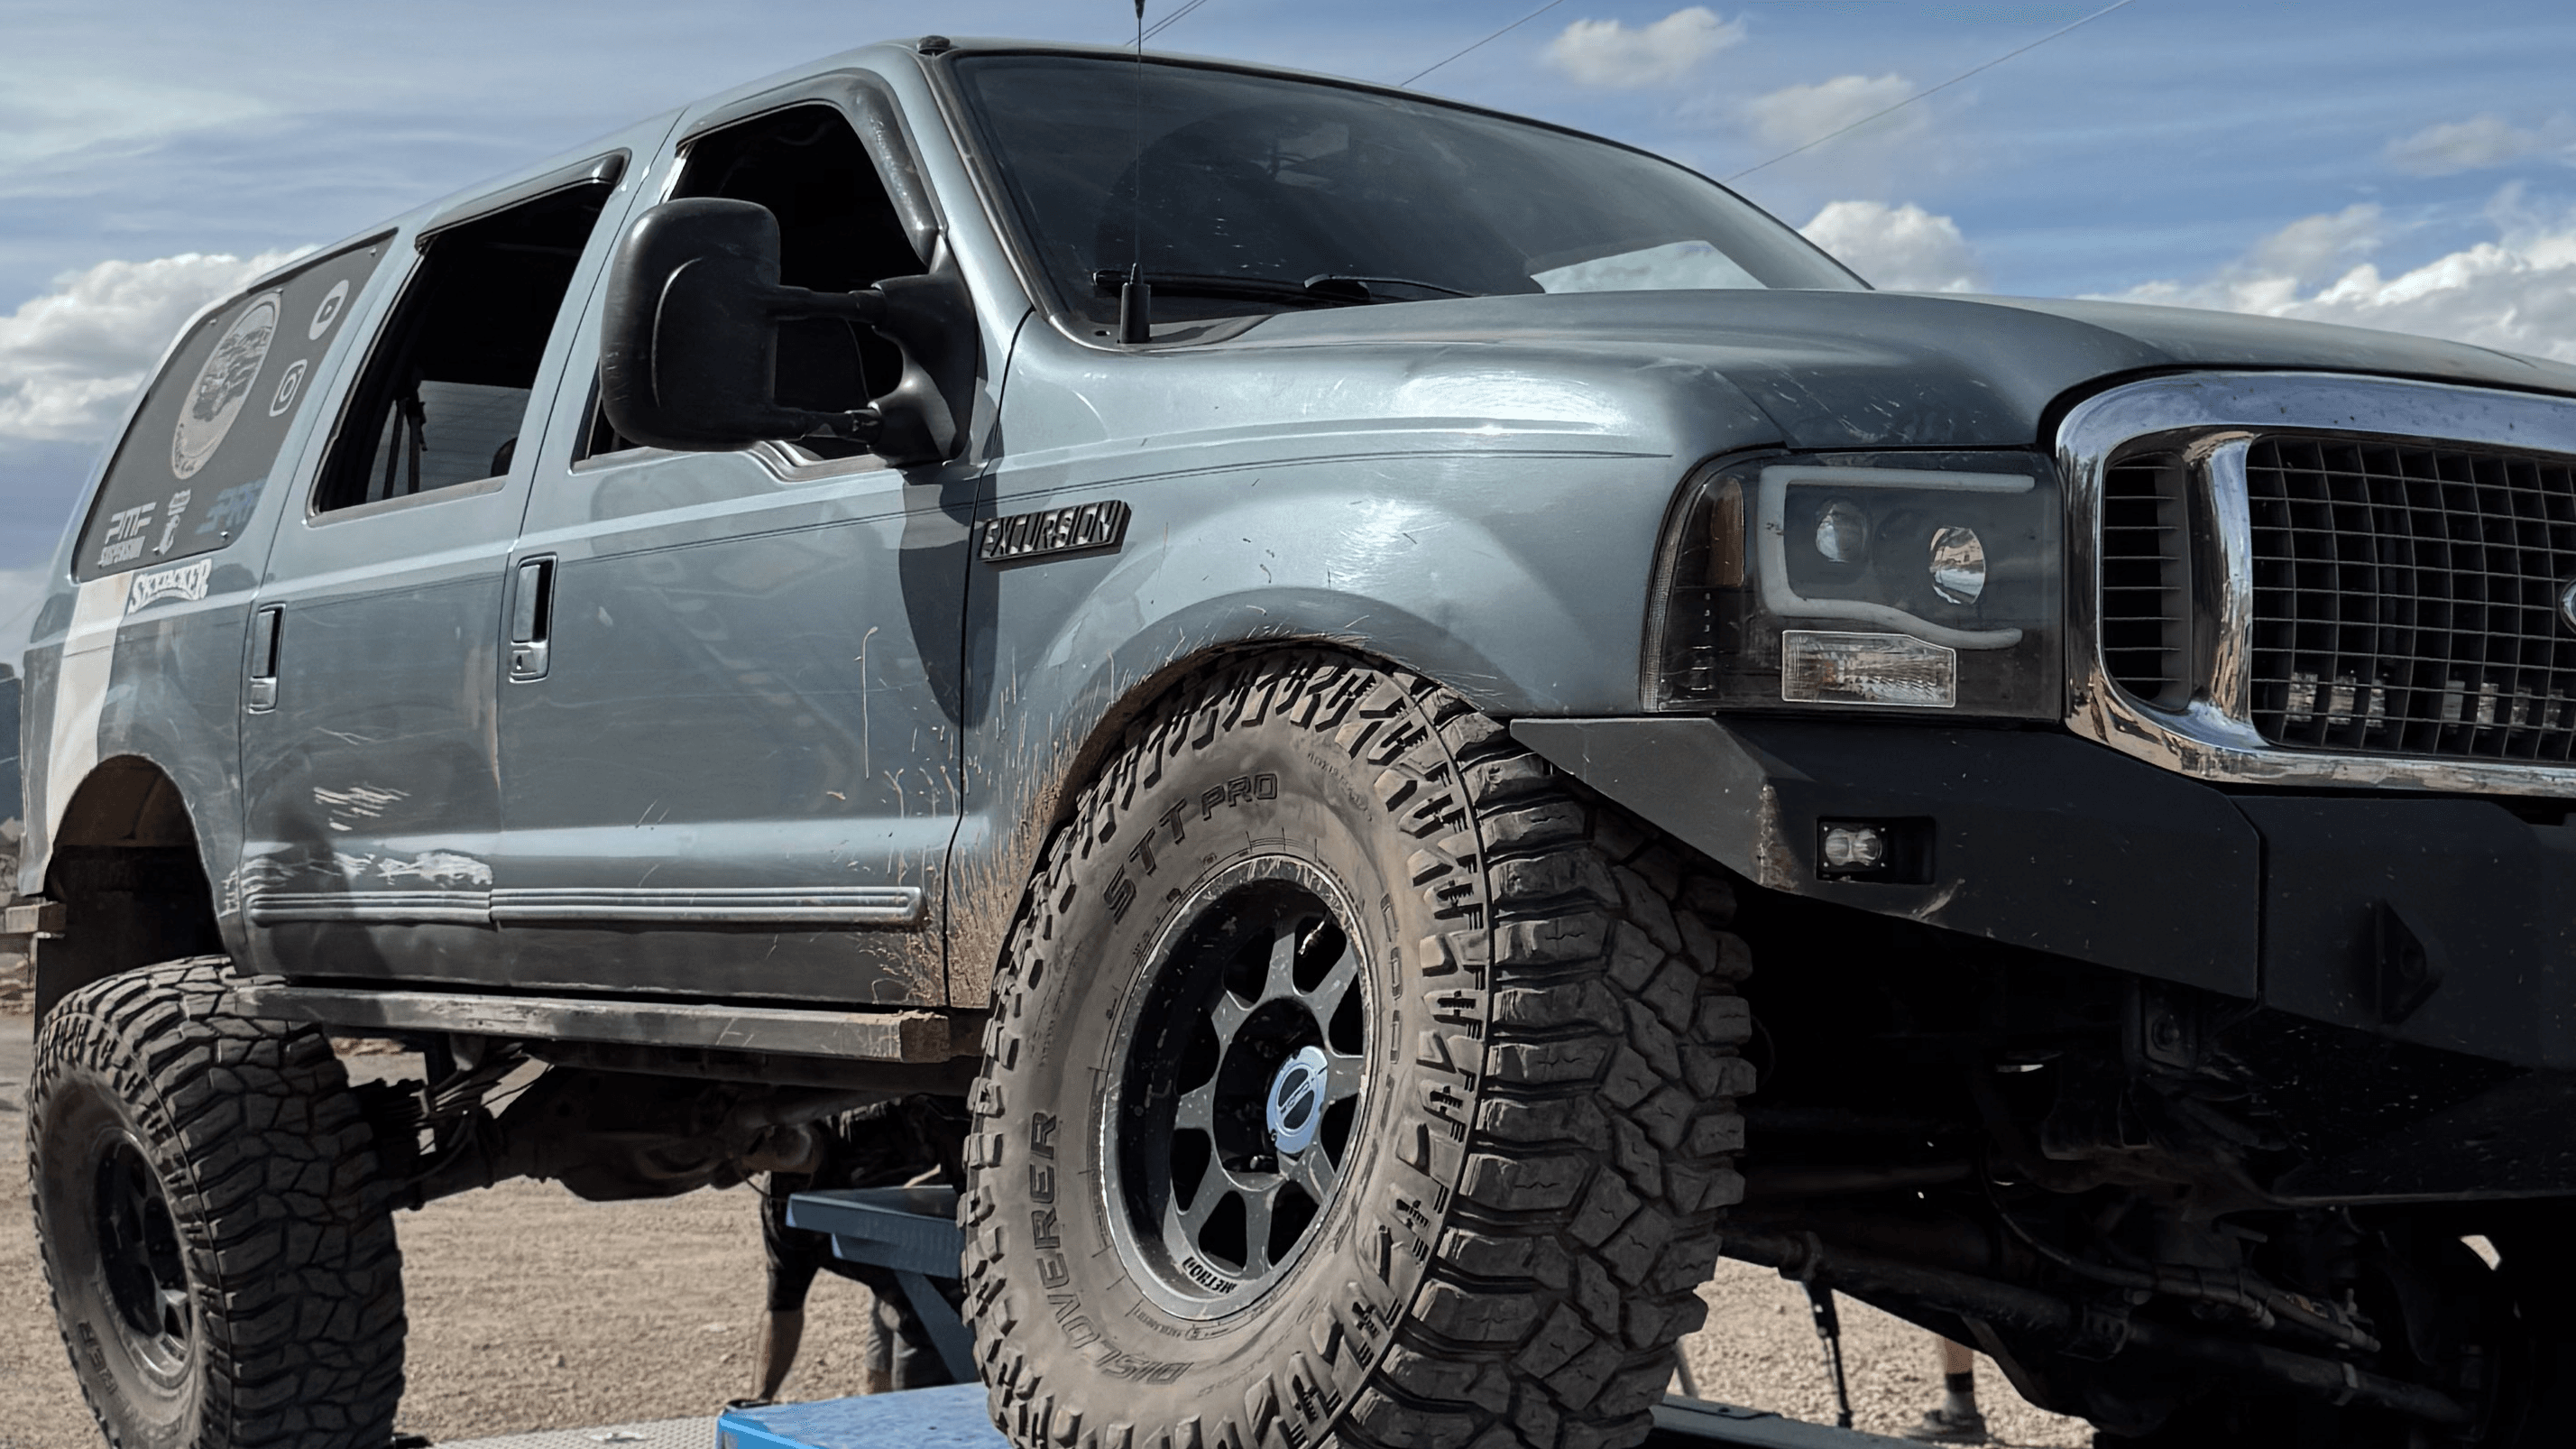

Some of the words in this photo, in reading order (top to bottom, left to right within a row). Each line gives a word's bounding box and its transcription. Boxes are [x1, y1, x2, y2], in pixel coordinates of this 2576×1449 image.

[979, 501, 1122, 558] EXCURSION
[1104, 796, 1187, 925] STT
[1201, 772, 1279, 822] PRO
[1029, 1112, 1195, 1385] DISCOVERER
[1181, 1256, 1237, 1295] METHOD
